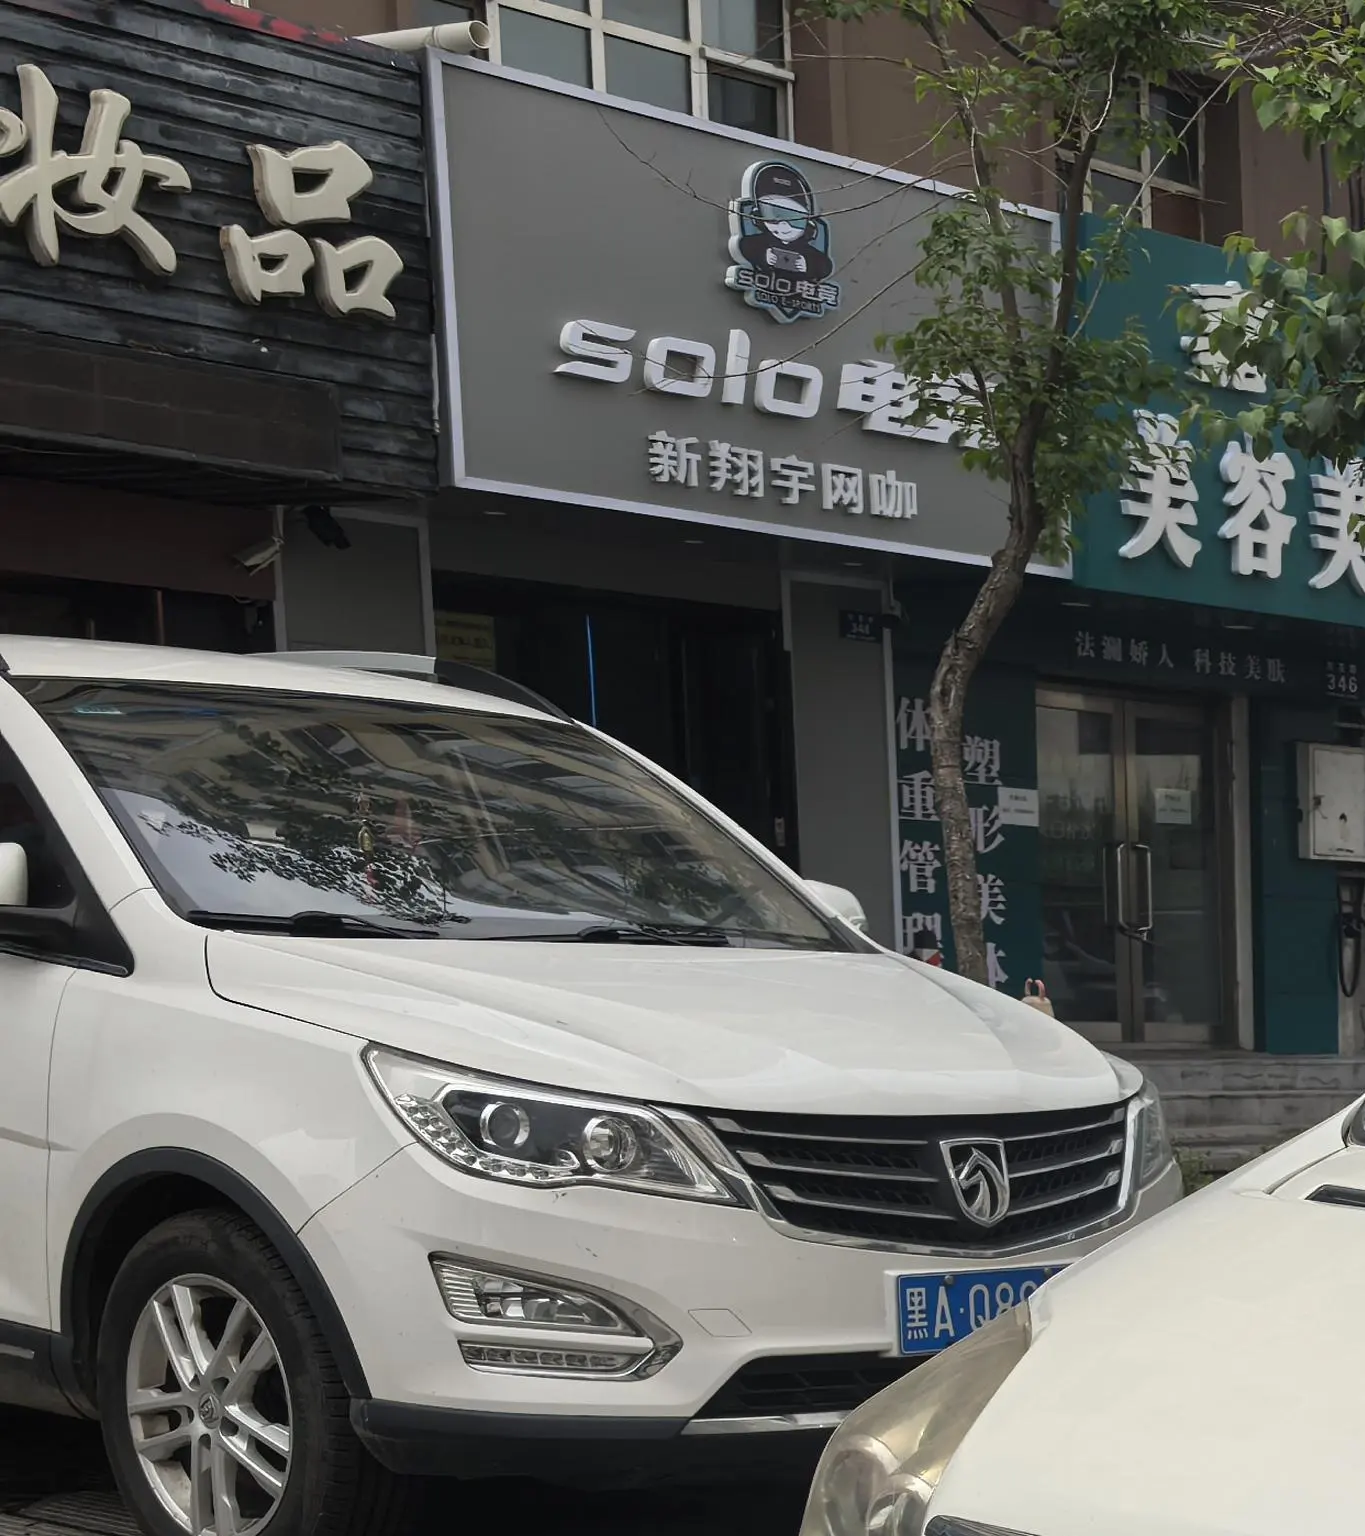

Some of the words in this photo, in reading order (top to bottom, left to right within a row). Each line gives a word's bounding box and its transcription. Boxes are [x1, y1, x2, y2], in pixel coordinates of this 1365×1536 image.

[0, 63, 404, 320] 妆品
[647, 430, 918, 519] 新翔宇网咖
[1325, 673, 1358, 693] 346
